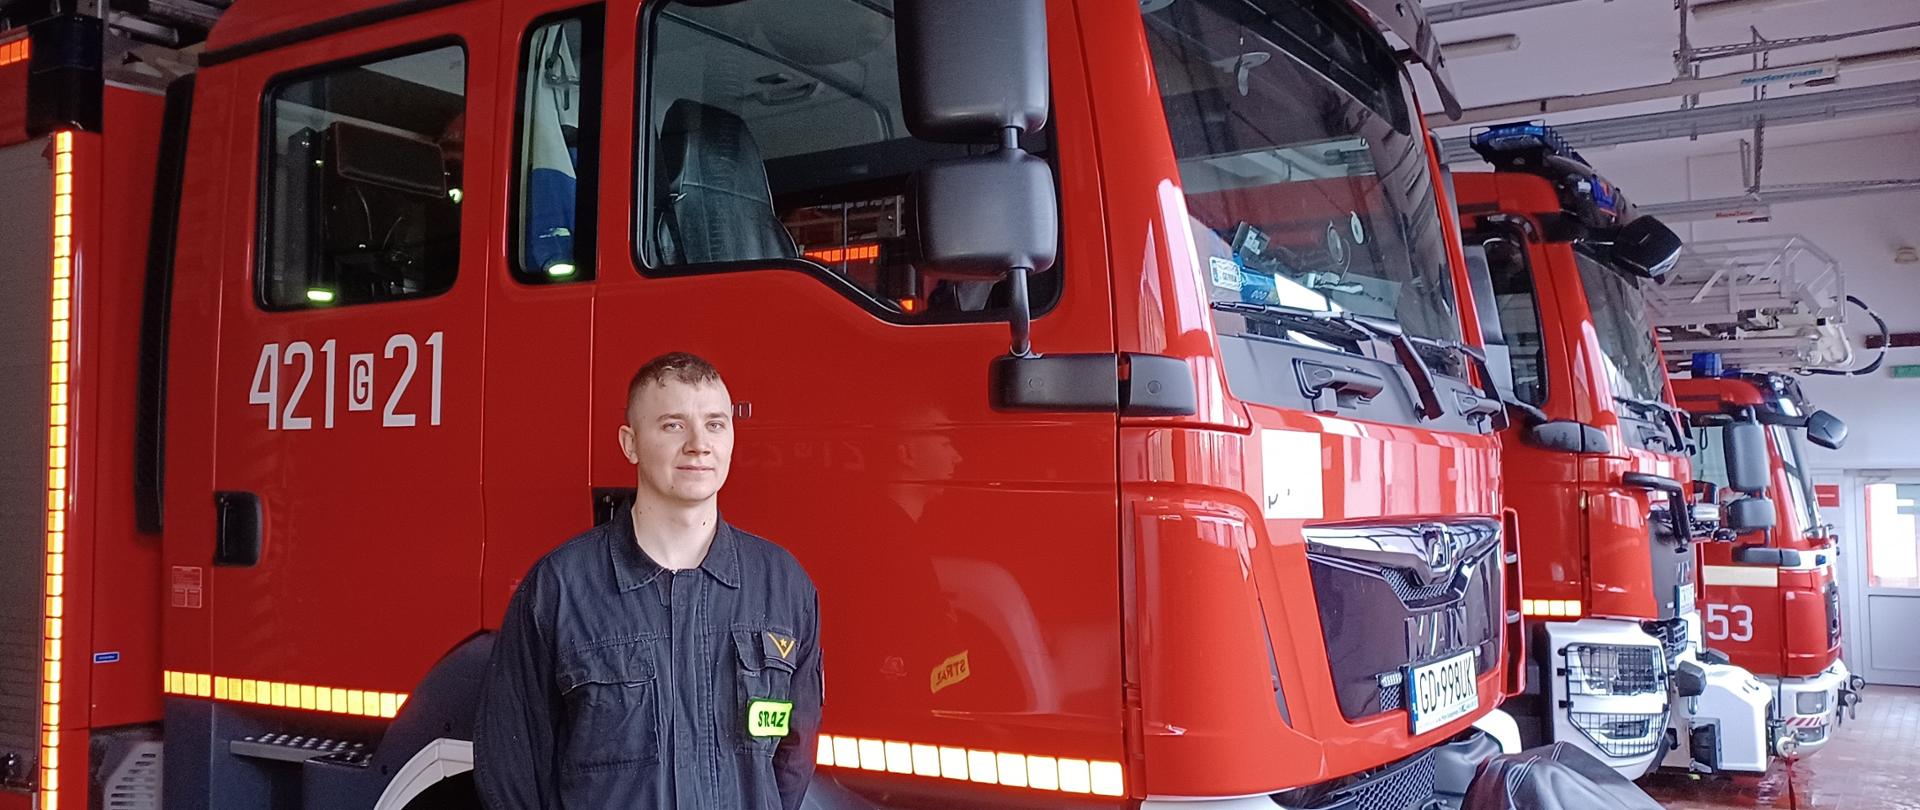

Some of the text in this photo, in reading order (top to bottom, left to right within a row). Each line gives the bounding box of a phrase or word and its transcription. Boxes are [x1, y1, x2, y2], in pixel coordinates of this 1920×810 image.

[249, 331, 444, 431] 421 G 21
[1404, 605, 1468, 662] MAN
[1706, 603, 1753, 642] 53
[1420, 669, 1437, 714] GD
